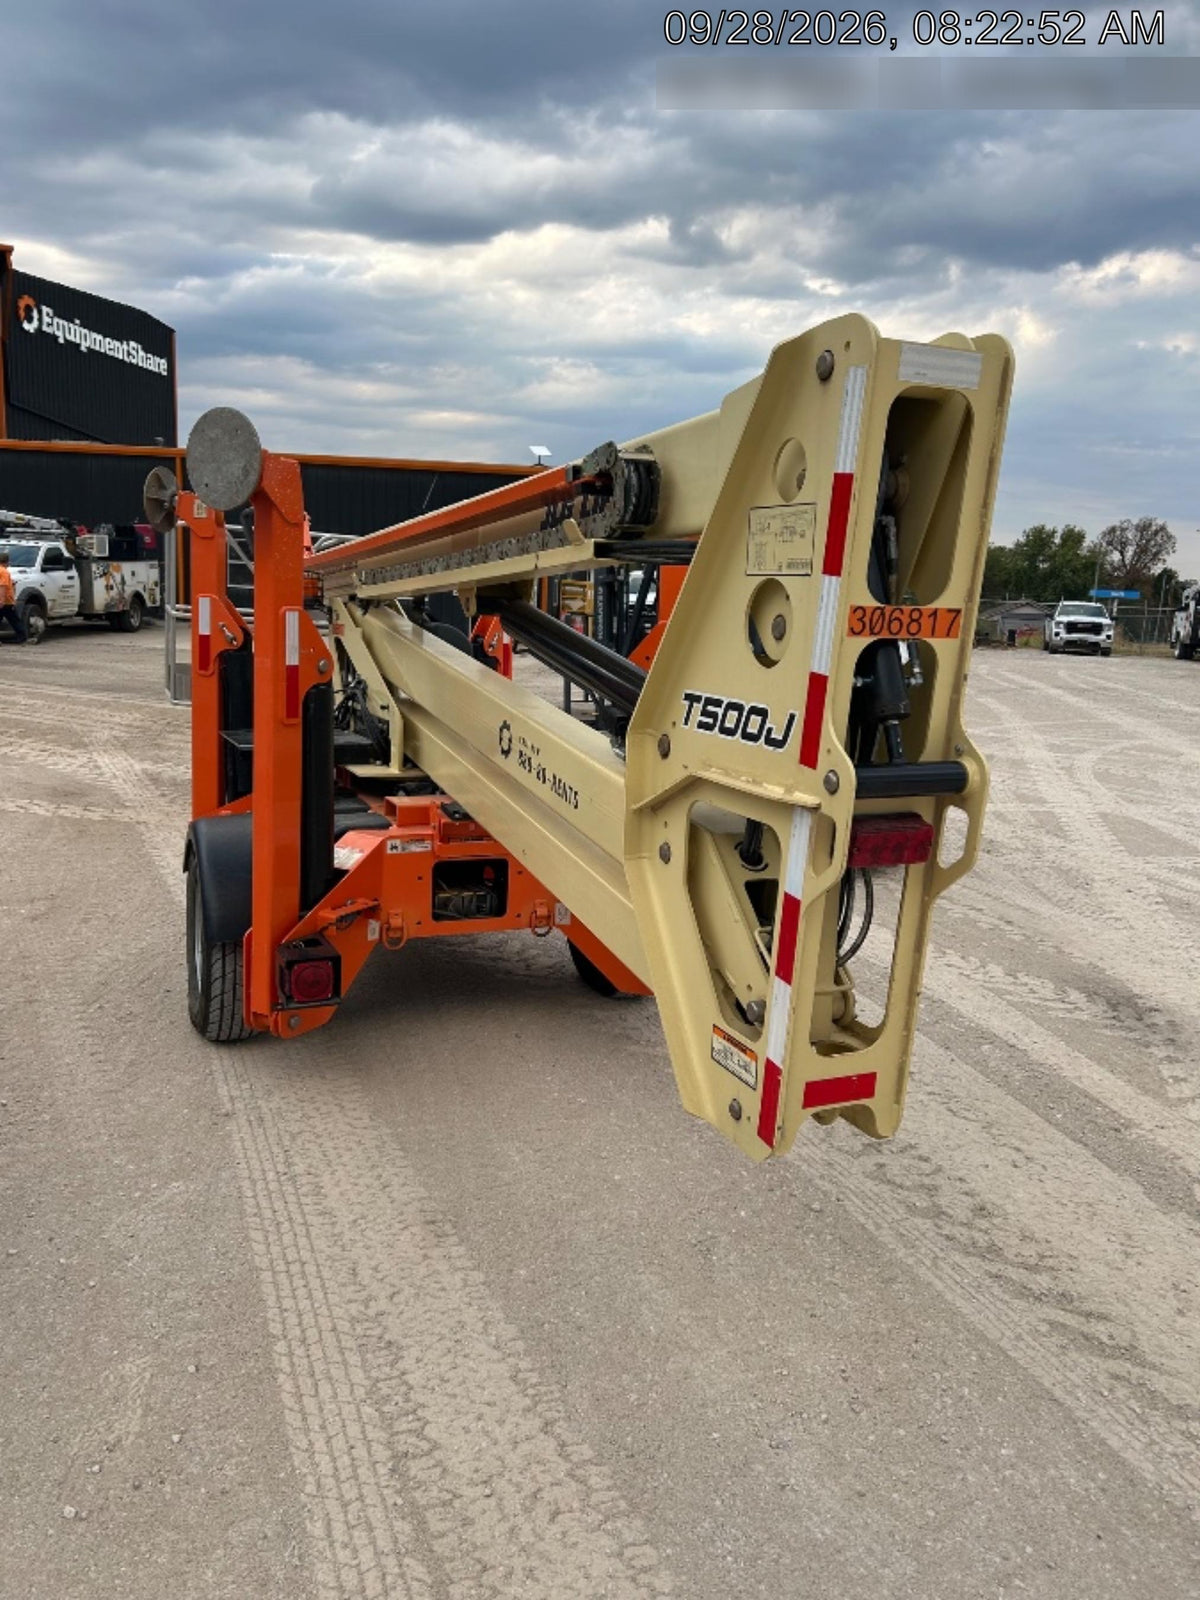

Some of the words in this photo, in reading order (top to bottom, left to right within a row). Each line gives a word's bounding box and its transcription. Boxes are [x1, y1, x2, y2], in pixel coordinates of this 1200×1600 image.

[41, 304, 168, 376] EquipmentShare
[849, 605, 962, 637] 306817
[682, 692, 797, 751] T500J
